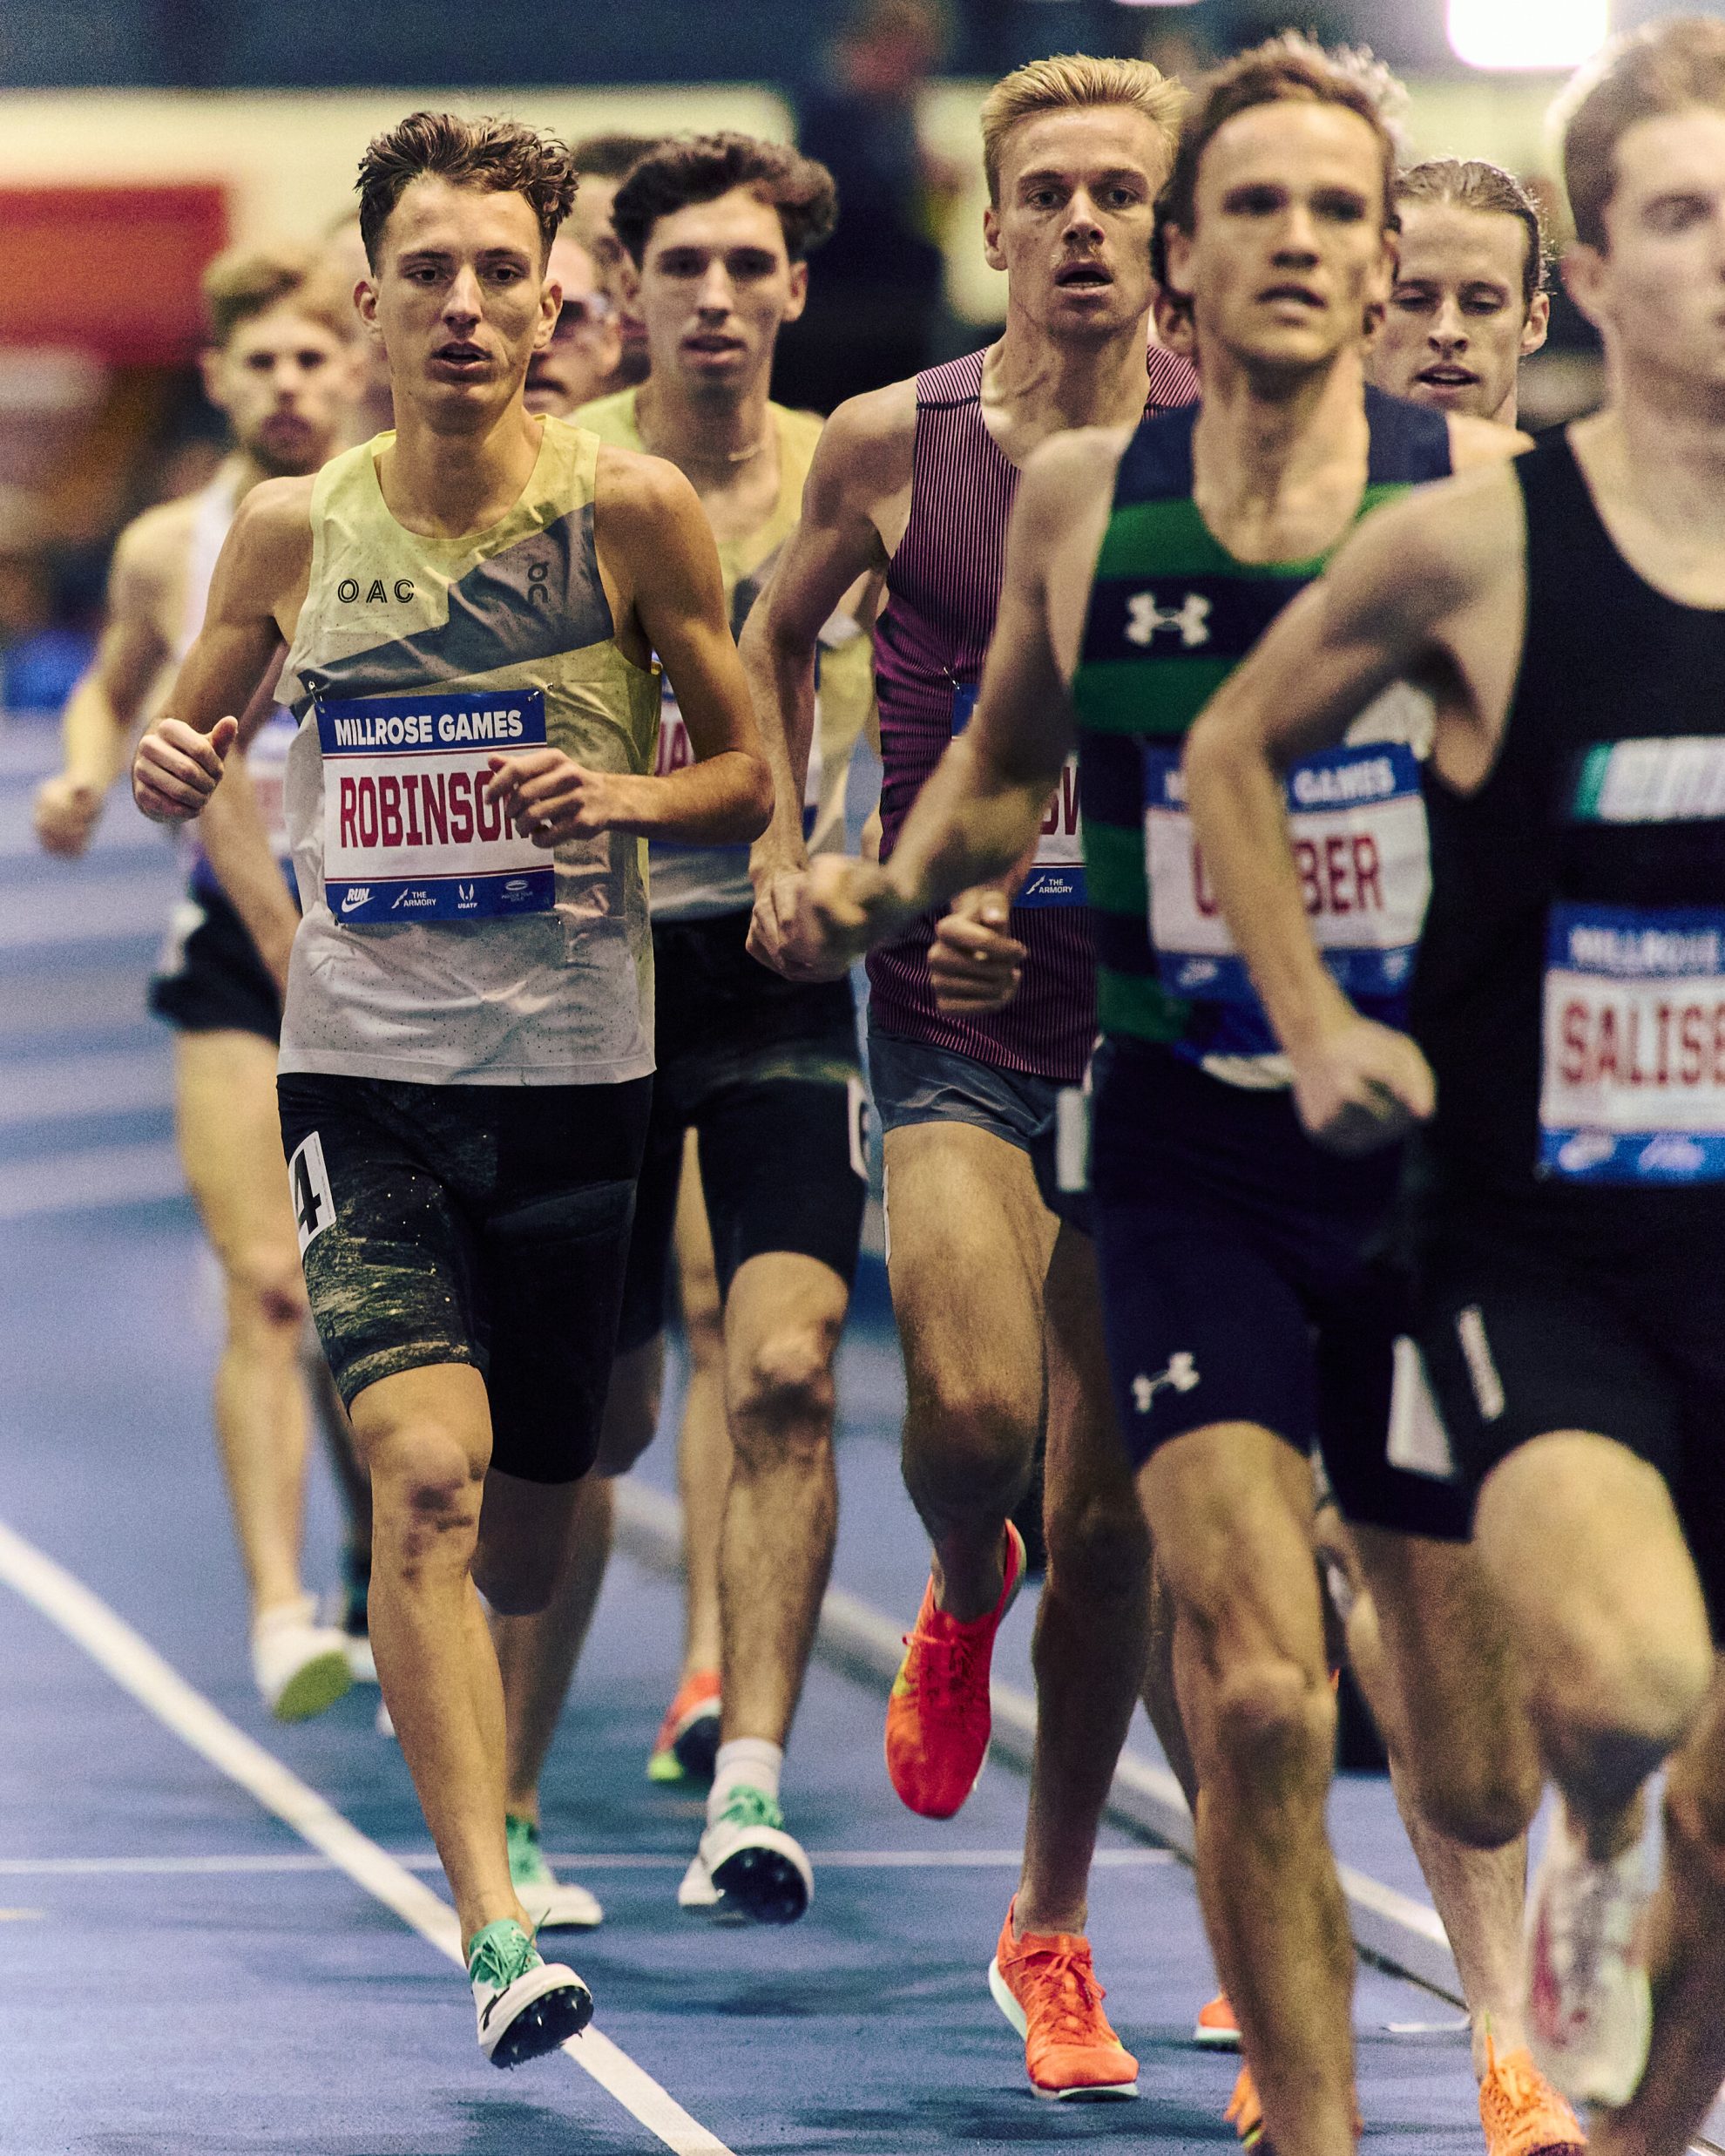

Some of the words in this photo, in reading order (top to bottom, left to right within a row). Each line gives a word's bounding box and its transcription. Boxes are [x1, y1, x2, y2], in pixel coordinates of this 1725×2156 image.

[337, 579, 415, 604] OAC
[334, 715, 434, 747] MILLROSE
[438, 709, 524, 742] GAMES
[340, 770, 530, 849] ROBINSO
[347, 887, 370, 902] RUN
[403, 898, 436, 907] ARMORY
[411, 891, 427, 899] THE
[294, 1149, 321, 1235] 4
